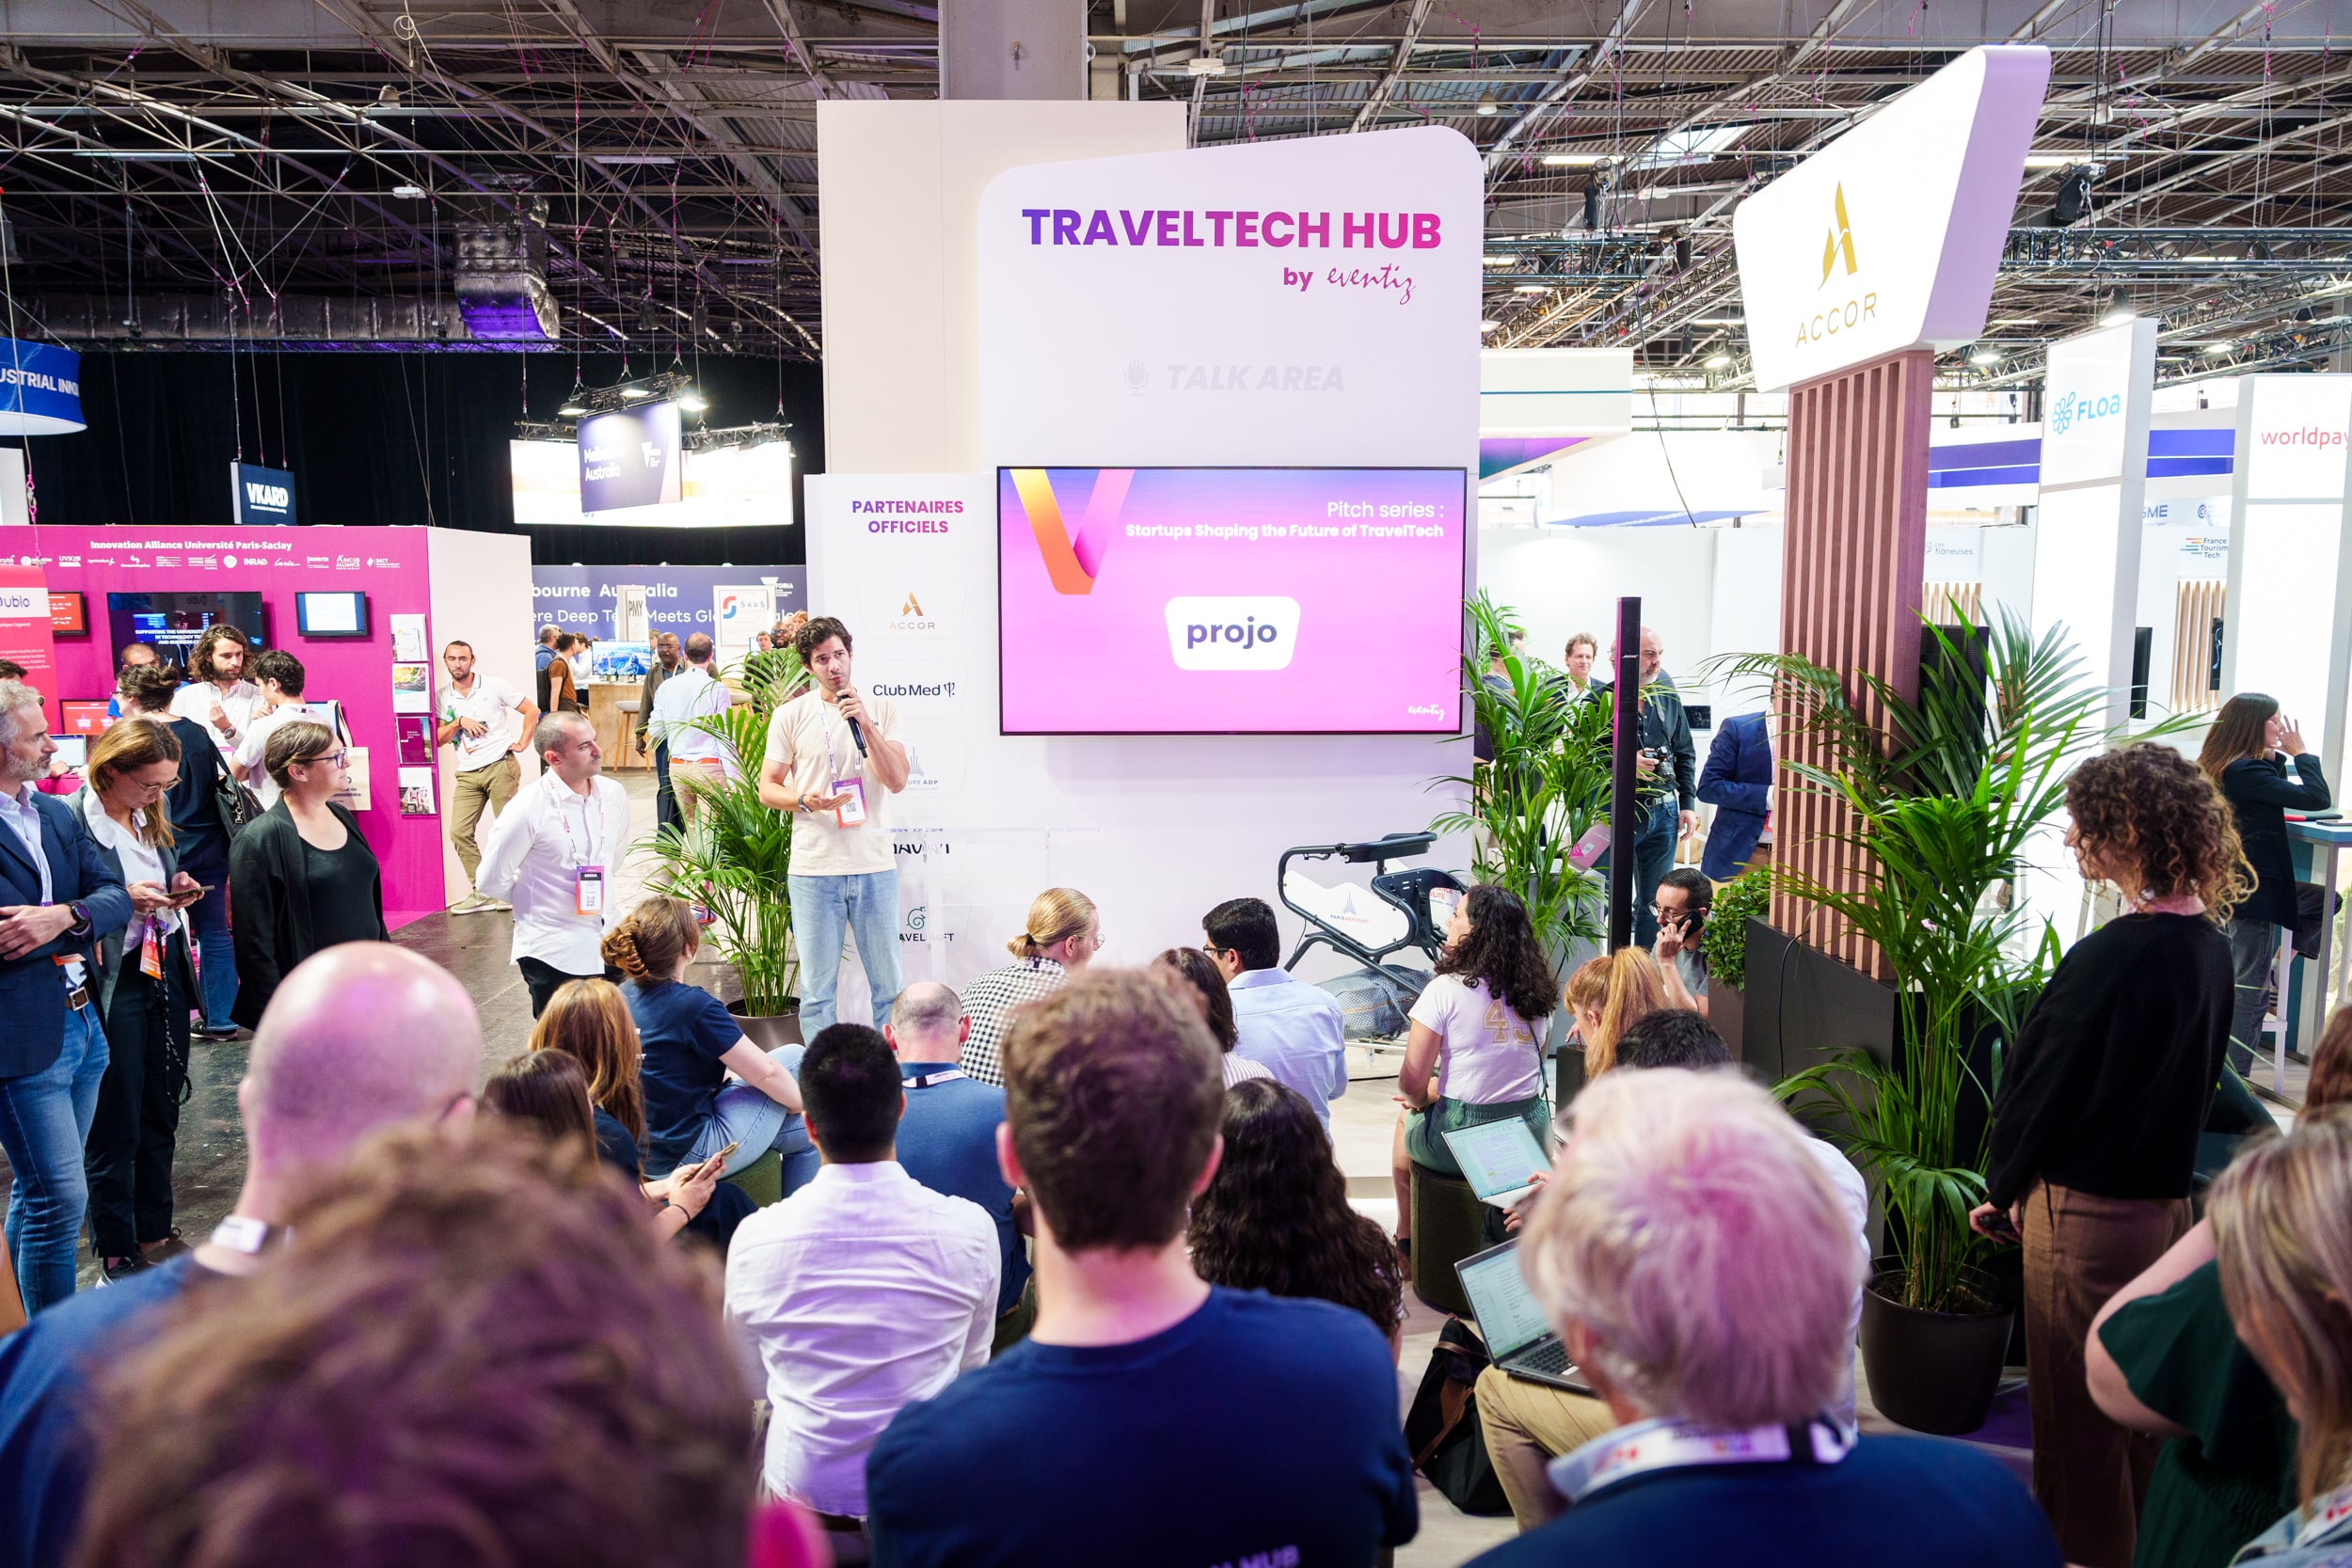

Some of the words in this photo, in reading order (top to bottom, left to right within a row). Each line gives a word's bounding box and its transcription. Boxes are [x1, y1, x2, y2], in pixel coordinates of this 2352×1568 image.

[1022, 209, 1330, 248] TRAVELTECH
[1343, 212, 1442, 249] HUB
[1283, 266, 1313, 292] by
[1327, 262, 1417, 305] eventiz
[1795, 292, 1877, 348] ACCOR
[1167, 364, 1252, 391] TALK
[1256, 366, 1345, 392] AREA
[584, 462, 621, 482] Australia
[246, 482, 289, 508] VKARD
[851, 500, 963, 514] PARTENAIRES
[1327, 500, 1375, 518] Pitch
[1378, 500, 1435, 518] series
[867, 520, 948, 533] OFFICIELS
[1125, 524, 1193, 539] Startups
[1195, 523, 1259, 541] Shaping
[1262, 523, 1286, 537] the
[1289, 524, 1340, 537] Future
[1342, 523, 1358, 537] of
[1359, 523, 1444, 538] TravelTech
[90, 540, 142, 550] Innovation
[144, 540, 183, 550] Alliance
[184, 539, 234, 550] Université
[236, 540, 293, 553] Paris-Saclay
[599, 583, 677, 597] Aualia
[557, 610, 598, 625] Deep
[647, 610, 691, 623] Meets
[628, 600, 644, 617] PMY
[1186, 615, 1278, 650] projo
[872, 684, 907, 696] Club
[909, 684, 941, 696] Med
[1407, 703, 1446, 721] eventiz
